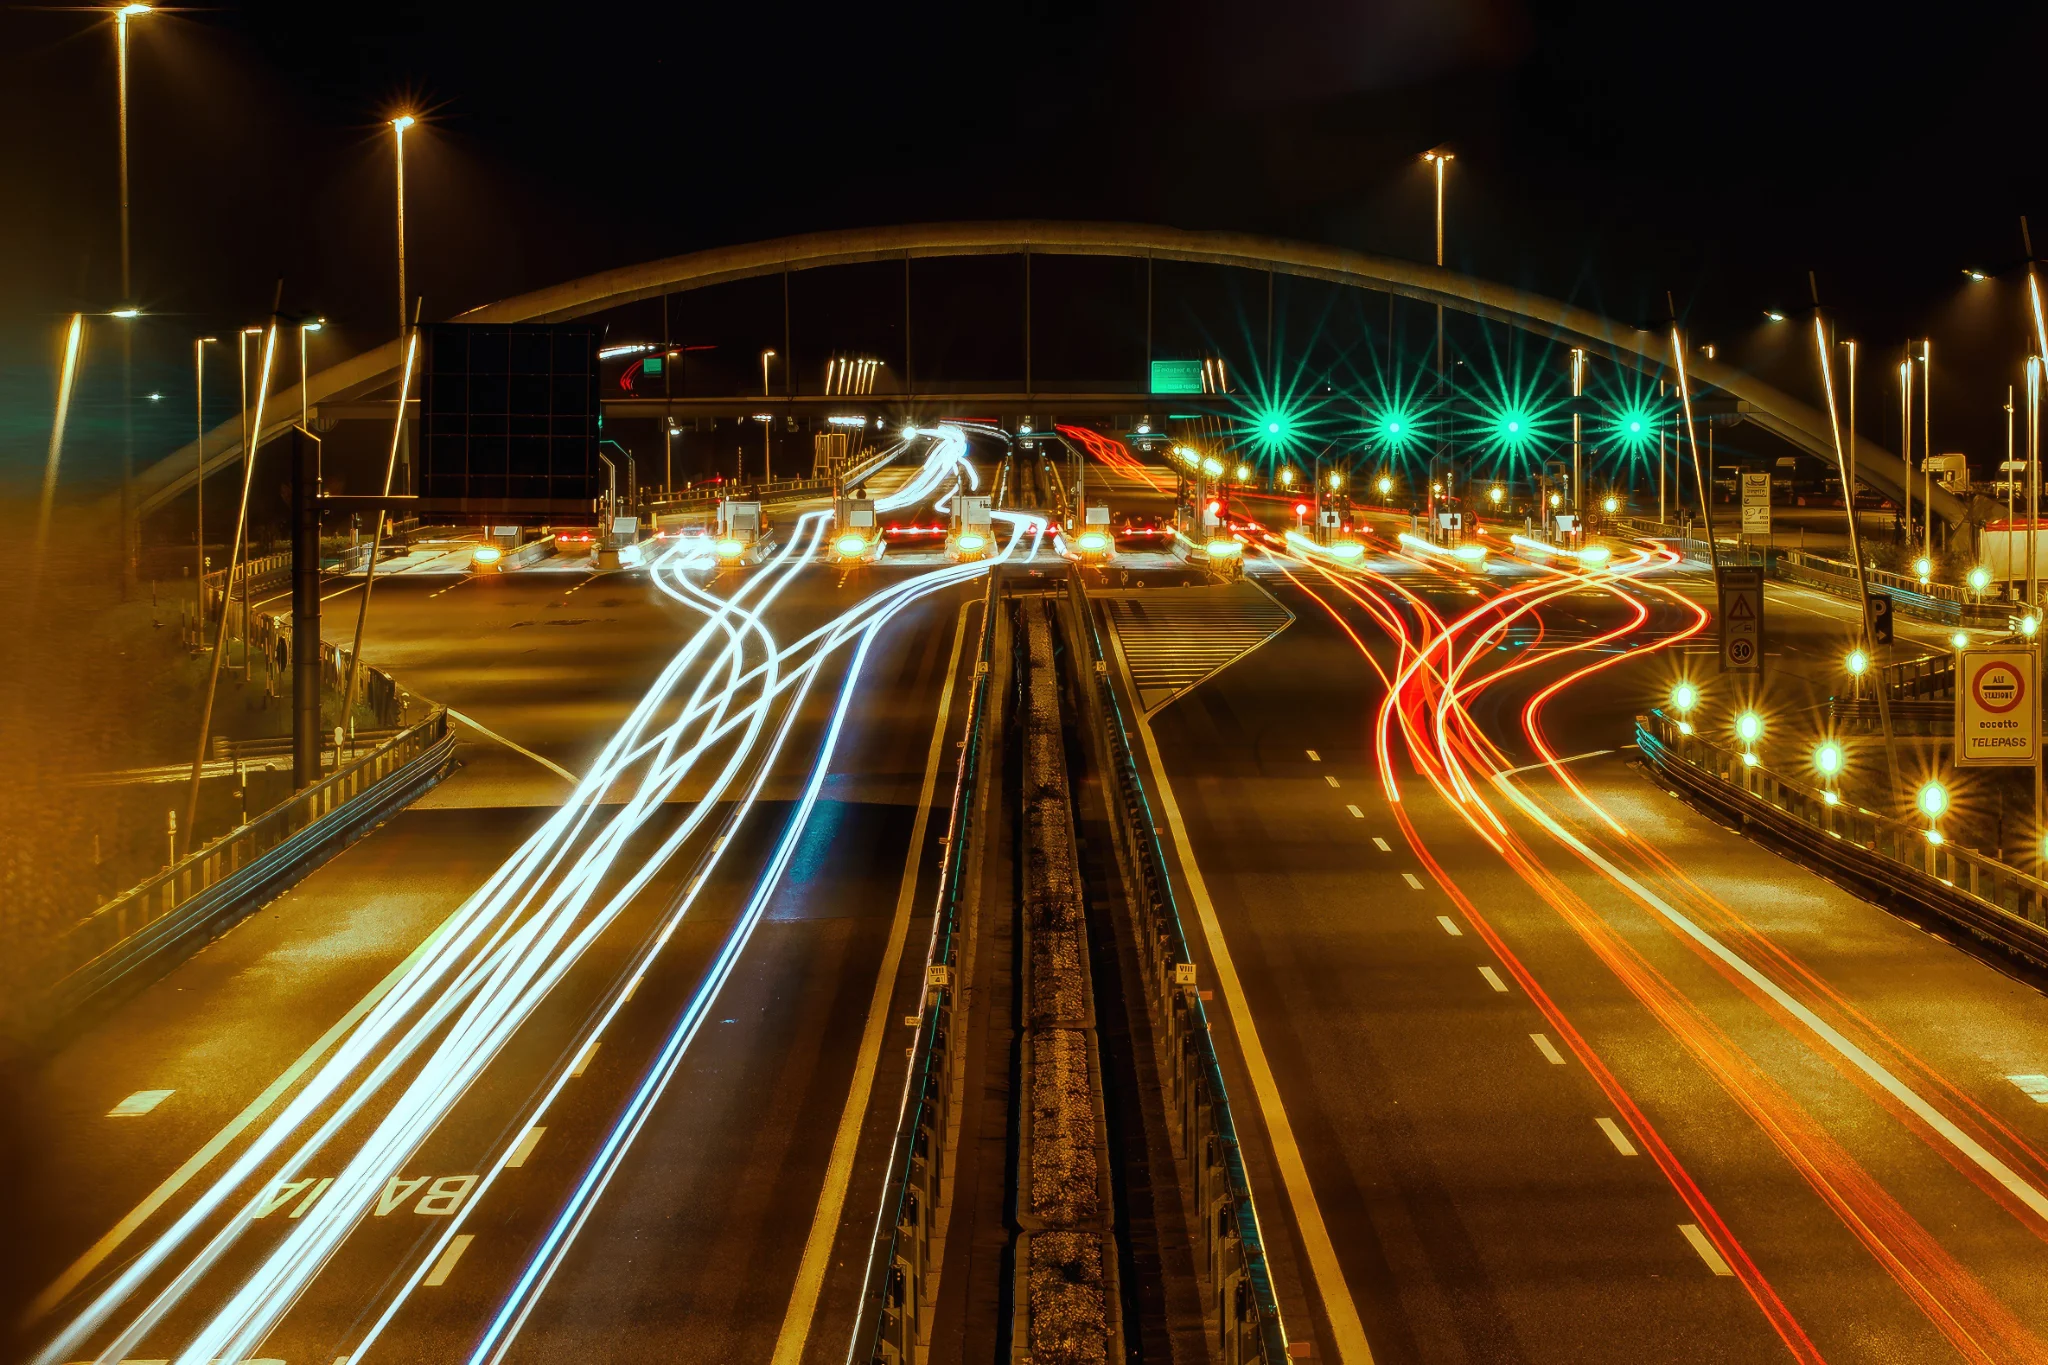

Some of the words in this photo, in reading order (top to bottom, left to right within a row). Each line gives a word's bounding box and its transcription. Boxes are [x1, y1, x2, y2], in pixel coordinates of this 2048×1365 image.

[1872, 600, 1886, 622] P
[1733, 644, 1750, 658] 30
[1980, 720, 2019, 729] eccetto
[1972, 737, 2027, 748] TELEPASS
[1180, 965, 1193, 973] VIII
